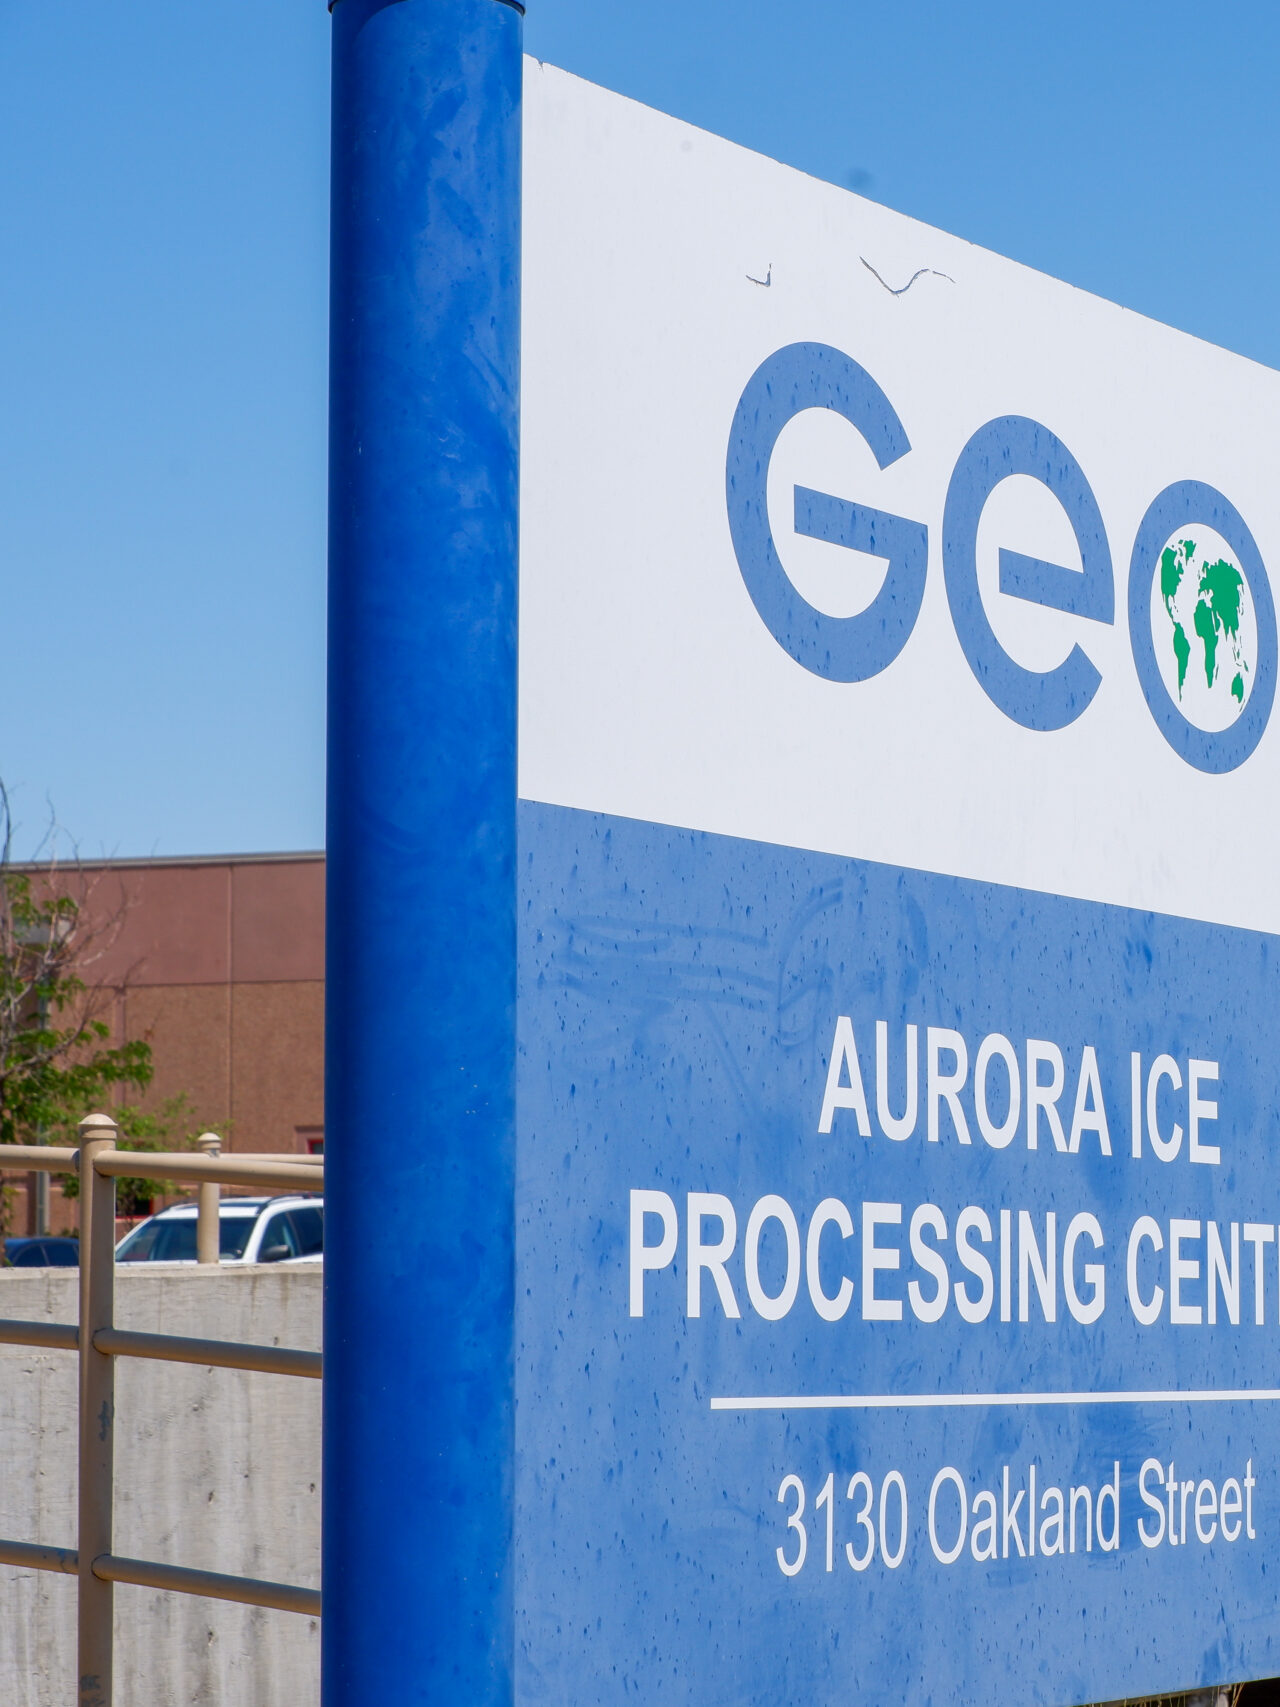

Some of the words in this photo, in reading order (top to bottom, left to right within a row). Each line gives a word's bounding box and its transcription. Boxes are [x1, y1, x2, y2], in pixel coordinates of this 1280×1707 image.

[817, 1015, 1113, 1156] AURORA
[1131, 1051, 1222, 1165] ICE
[629, 1189, 1105, 1325] PROCESSING
[776, 1470, 908, 1577] 3130
[928, 1460, 1120, 1565] Oakland
[1137, 1457, 1256, 1549] Street
